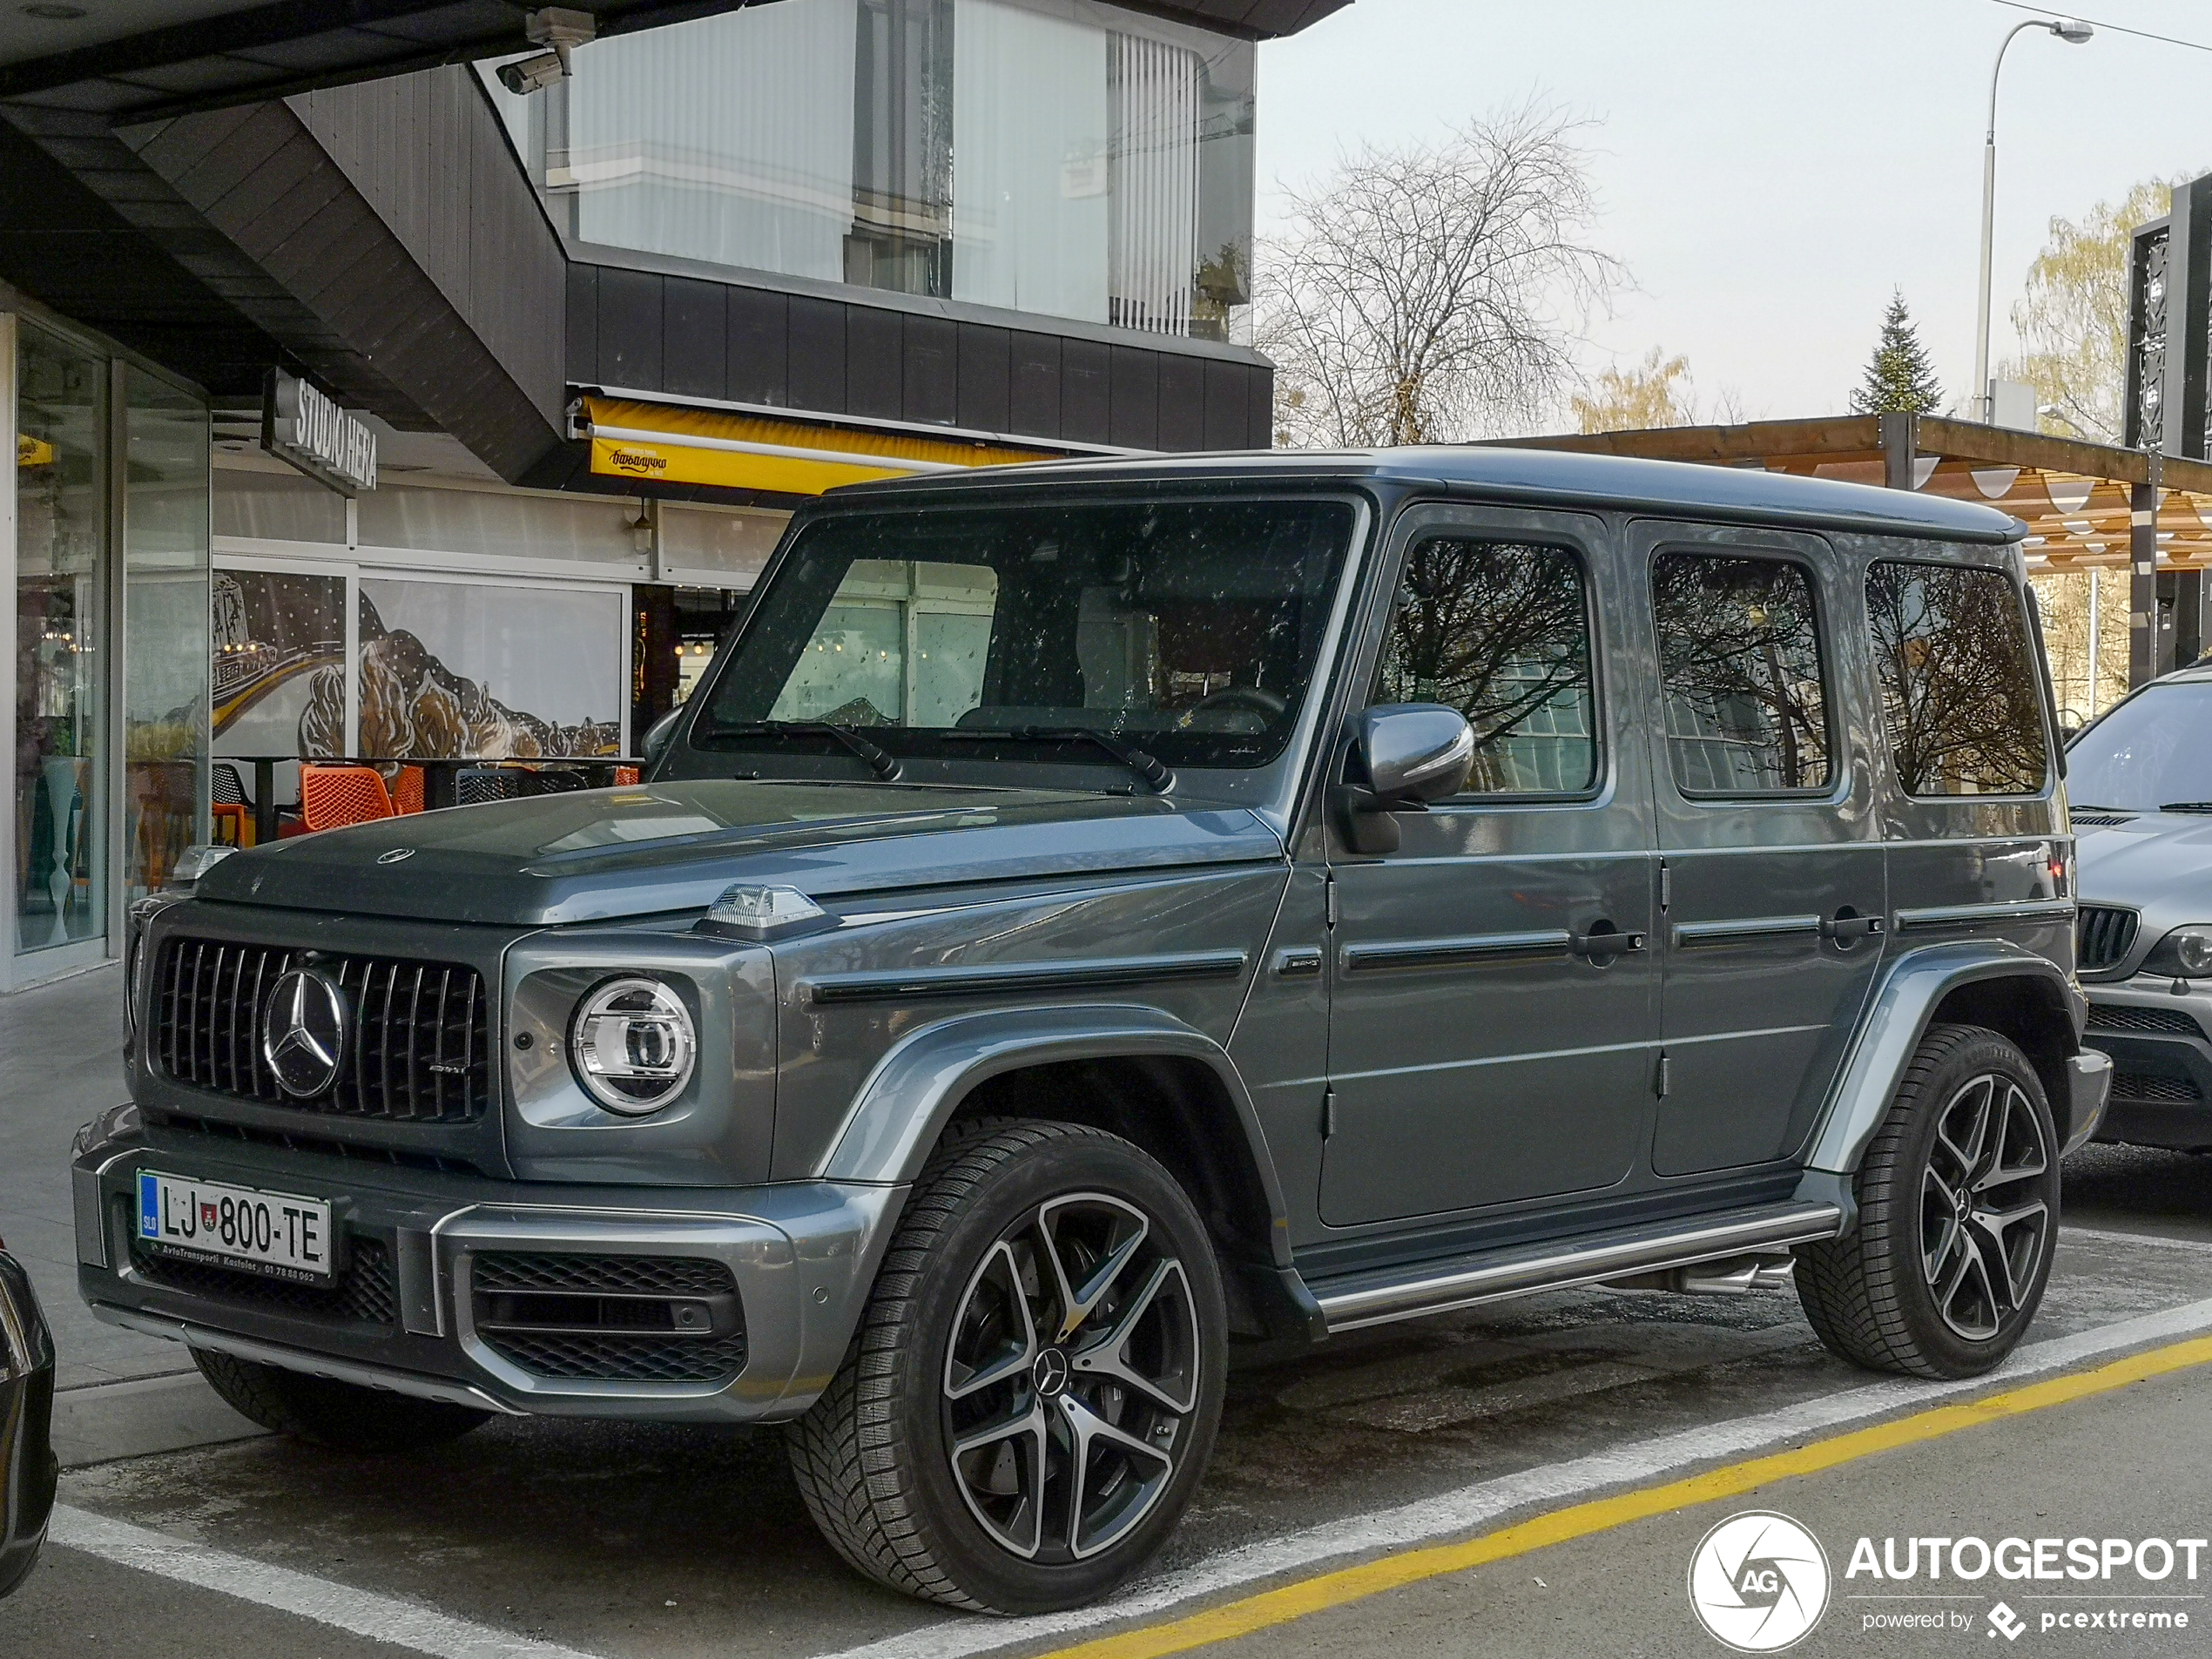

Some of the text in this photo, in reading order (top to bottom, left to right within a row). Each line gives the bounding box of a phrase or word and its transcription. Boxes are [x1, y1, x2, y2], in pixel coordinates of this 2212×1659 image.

[296, 377, 377, 491] STUDIO HERA
[144, 1215, 157, 1231] SLO
[164, 1186, 322, 1262] LJ 800-TE
